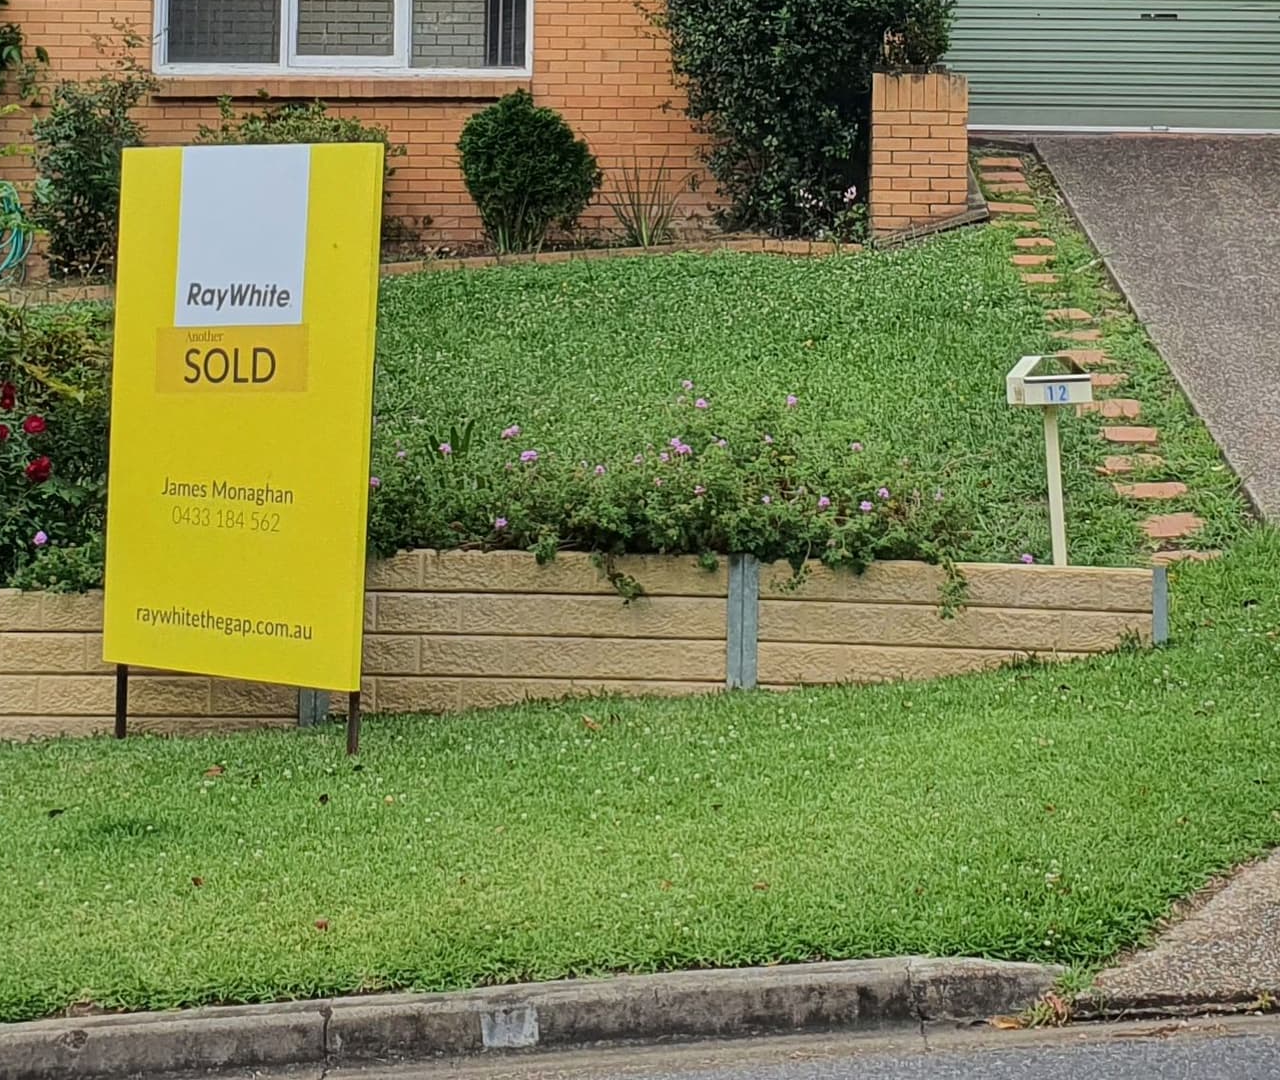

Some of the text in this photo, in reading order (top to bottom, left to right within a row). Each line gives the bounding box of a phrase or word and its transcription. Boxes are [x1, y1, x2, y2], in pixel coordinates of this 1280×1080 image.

[185, 330, 224, 342] Another
[184, 347, 276, 384] SOLD
[1047, 385, 1067, 401] 12
[161, 476, 294, 506] James Monaghan
[172, 505, 281, 533] 0433 184 562
[136, 605, 313, 640] raywhitethegap.com.au
